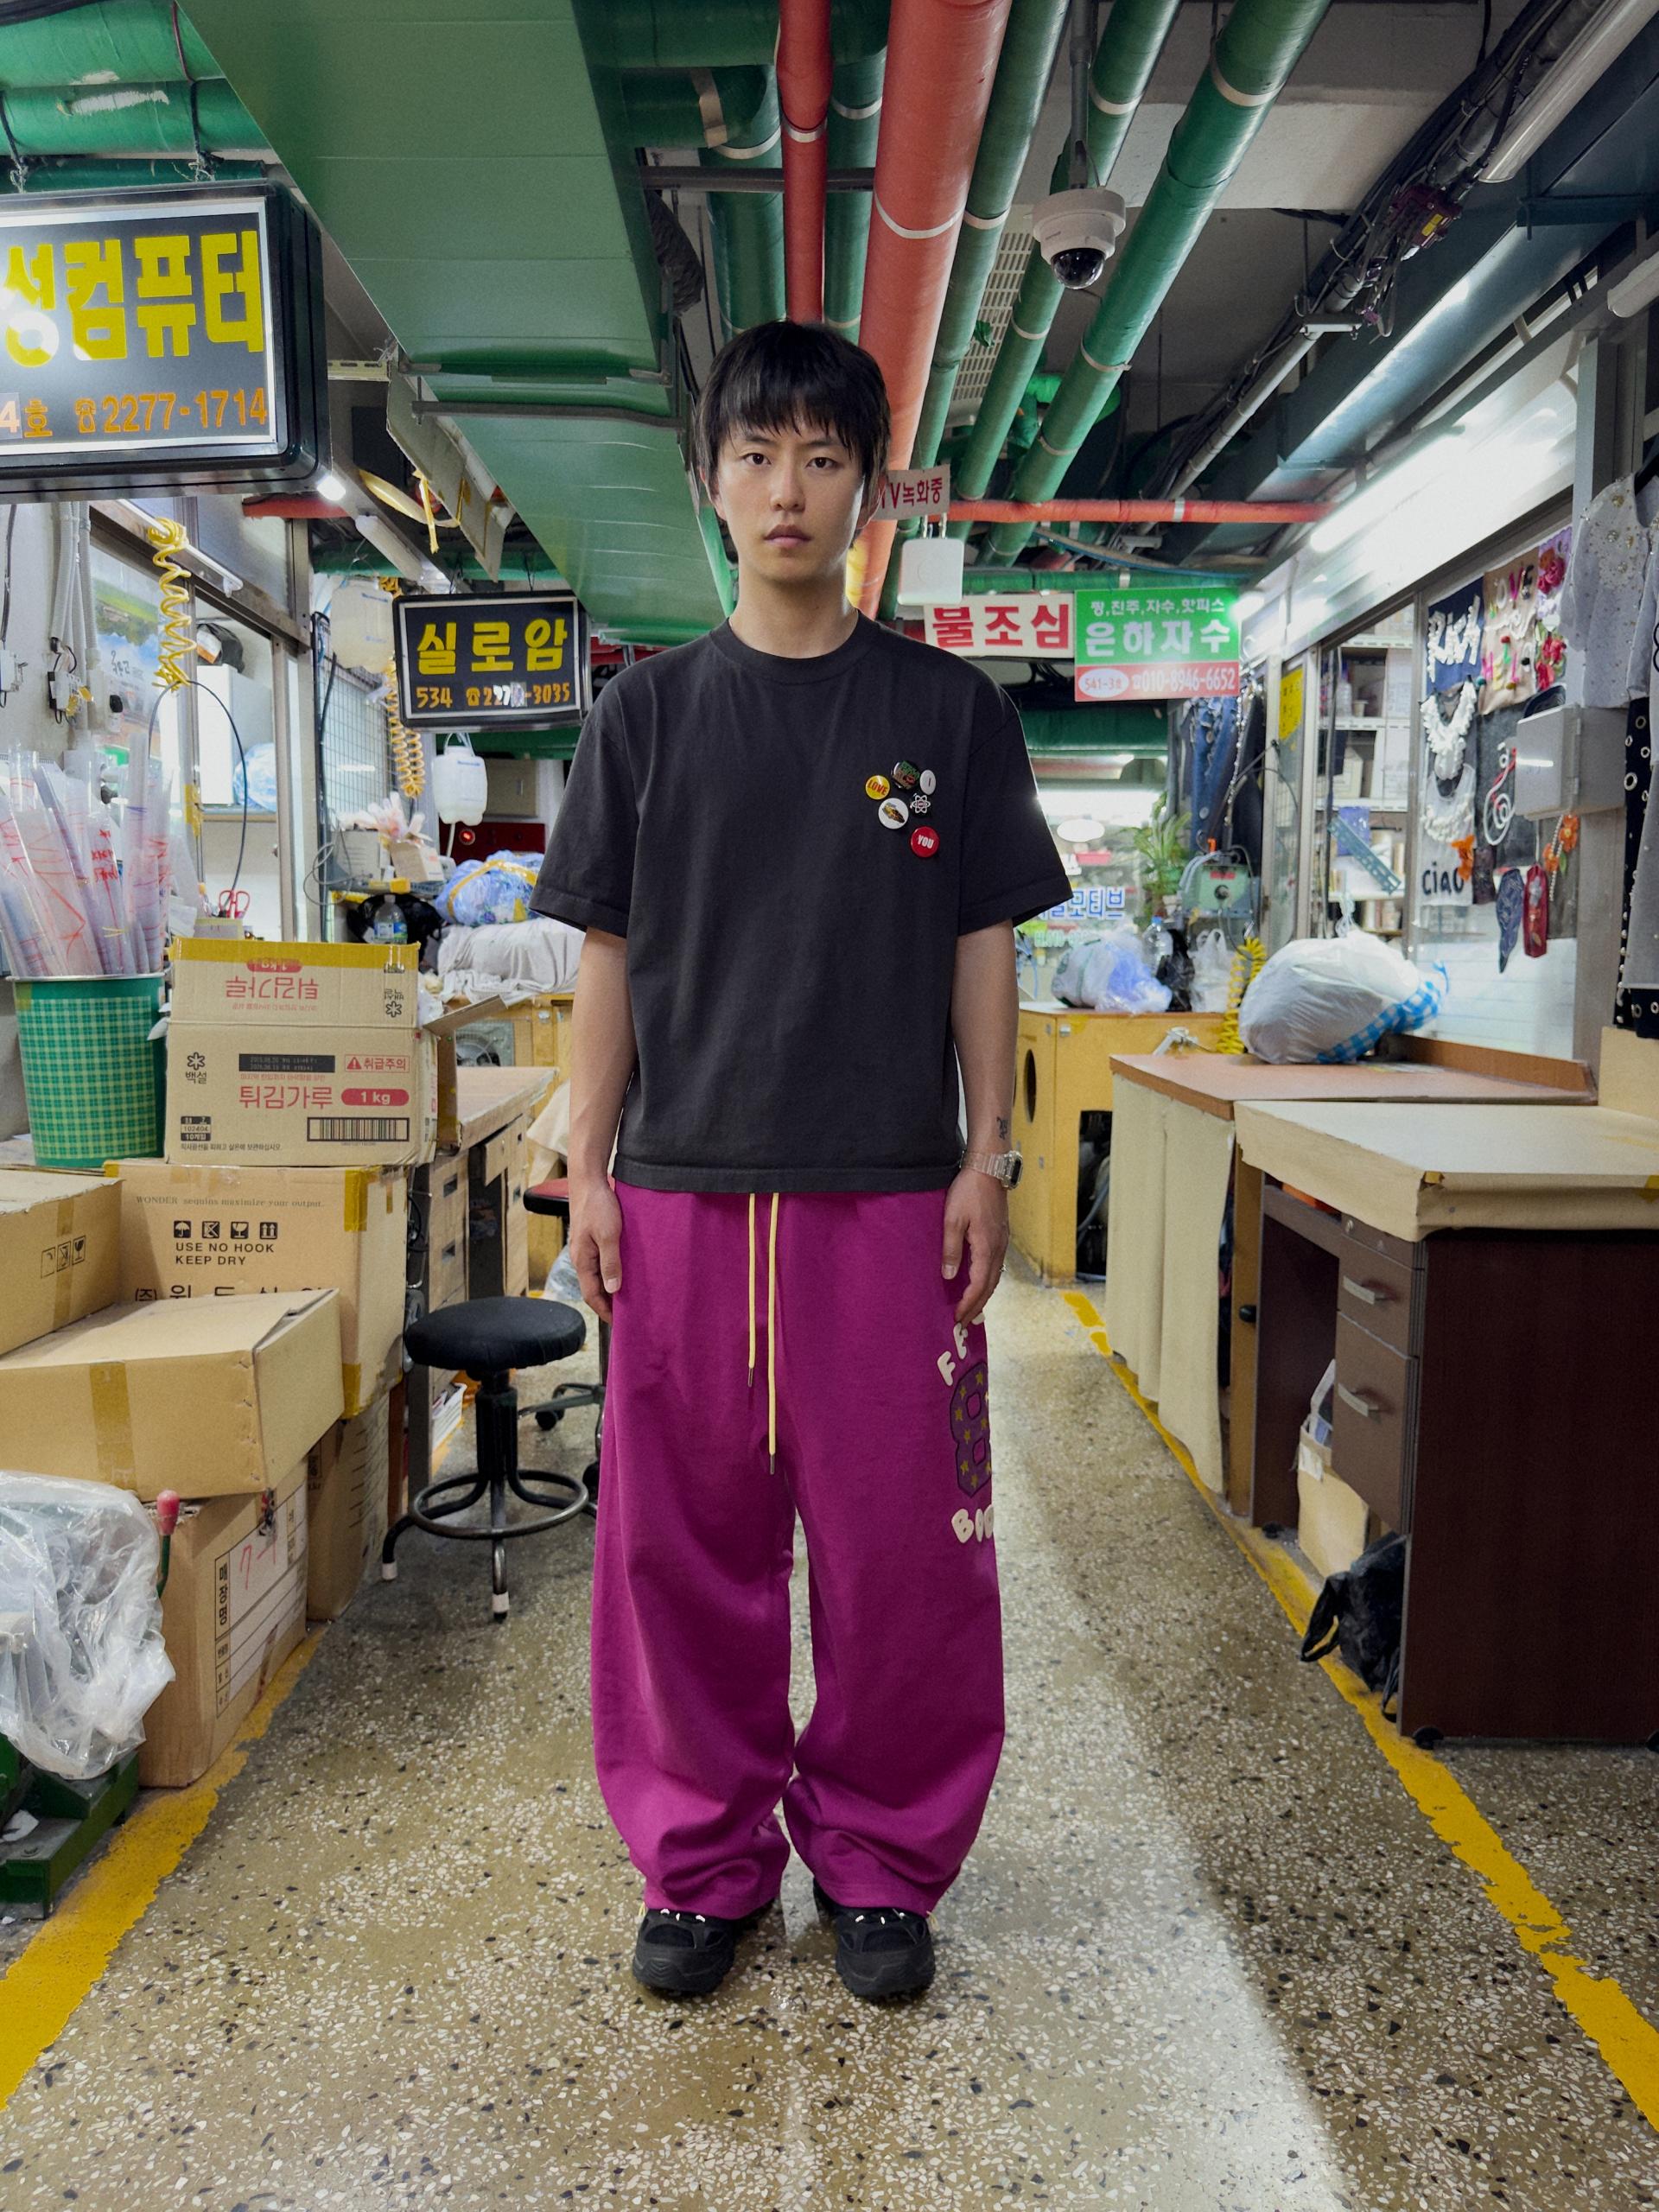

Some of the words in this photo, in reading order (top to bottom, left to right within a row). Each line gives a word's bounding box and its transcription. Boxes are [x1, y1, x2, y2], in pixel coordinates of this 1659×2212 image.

[3, 230, 264, 368] 성컴퓨터
[102, 387, 268, 434] 2277-1714
[416, 617, 569, 676] 실로암
[1084, 619, 1230, 658] 은하자수
[416, 686, 454, 709] 534
[483, 681, 570, 708] 227-3035
[868, 779, 888, 796] LOVE
[918, 835, 934, 849] YOU
[226, 976, 320, 1000] 튀김가루
[363, 1057, 406, 1071] 취급주의
[185, 1071, 207, 1084] 백설
[239, 1085, 333, 1109] 튀김가루
[136, 1196, 178, 1205] WONDER
[175, 1243, 203, 1252] USE
[209, 1243, 228, 1252] NO
[234, 1243, 274, 1253] HOOK
[175, 1255, 212, 1265] KEEP
[218, 1255, 246, 1266] DRY
